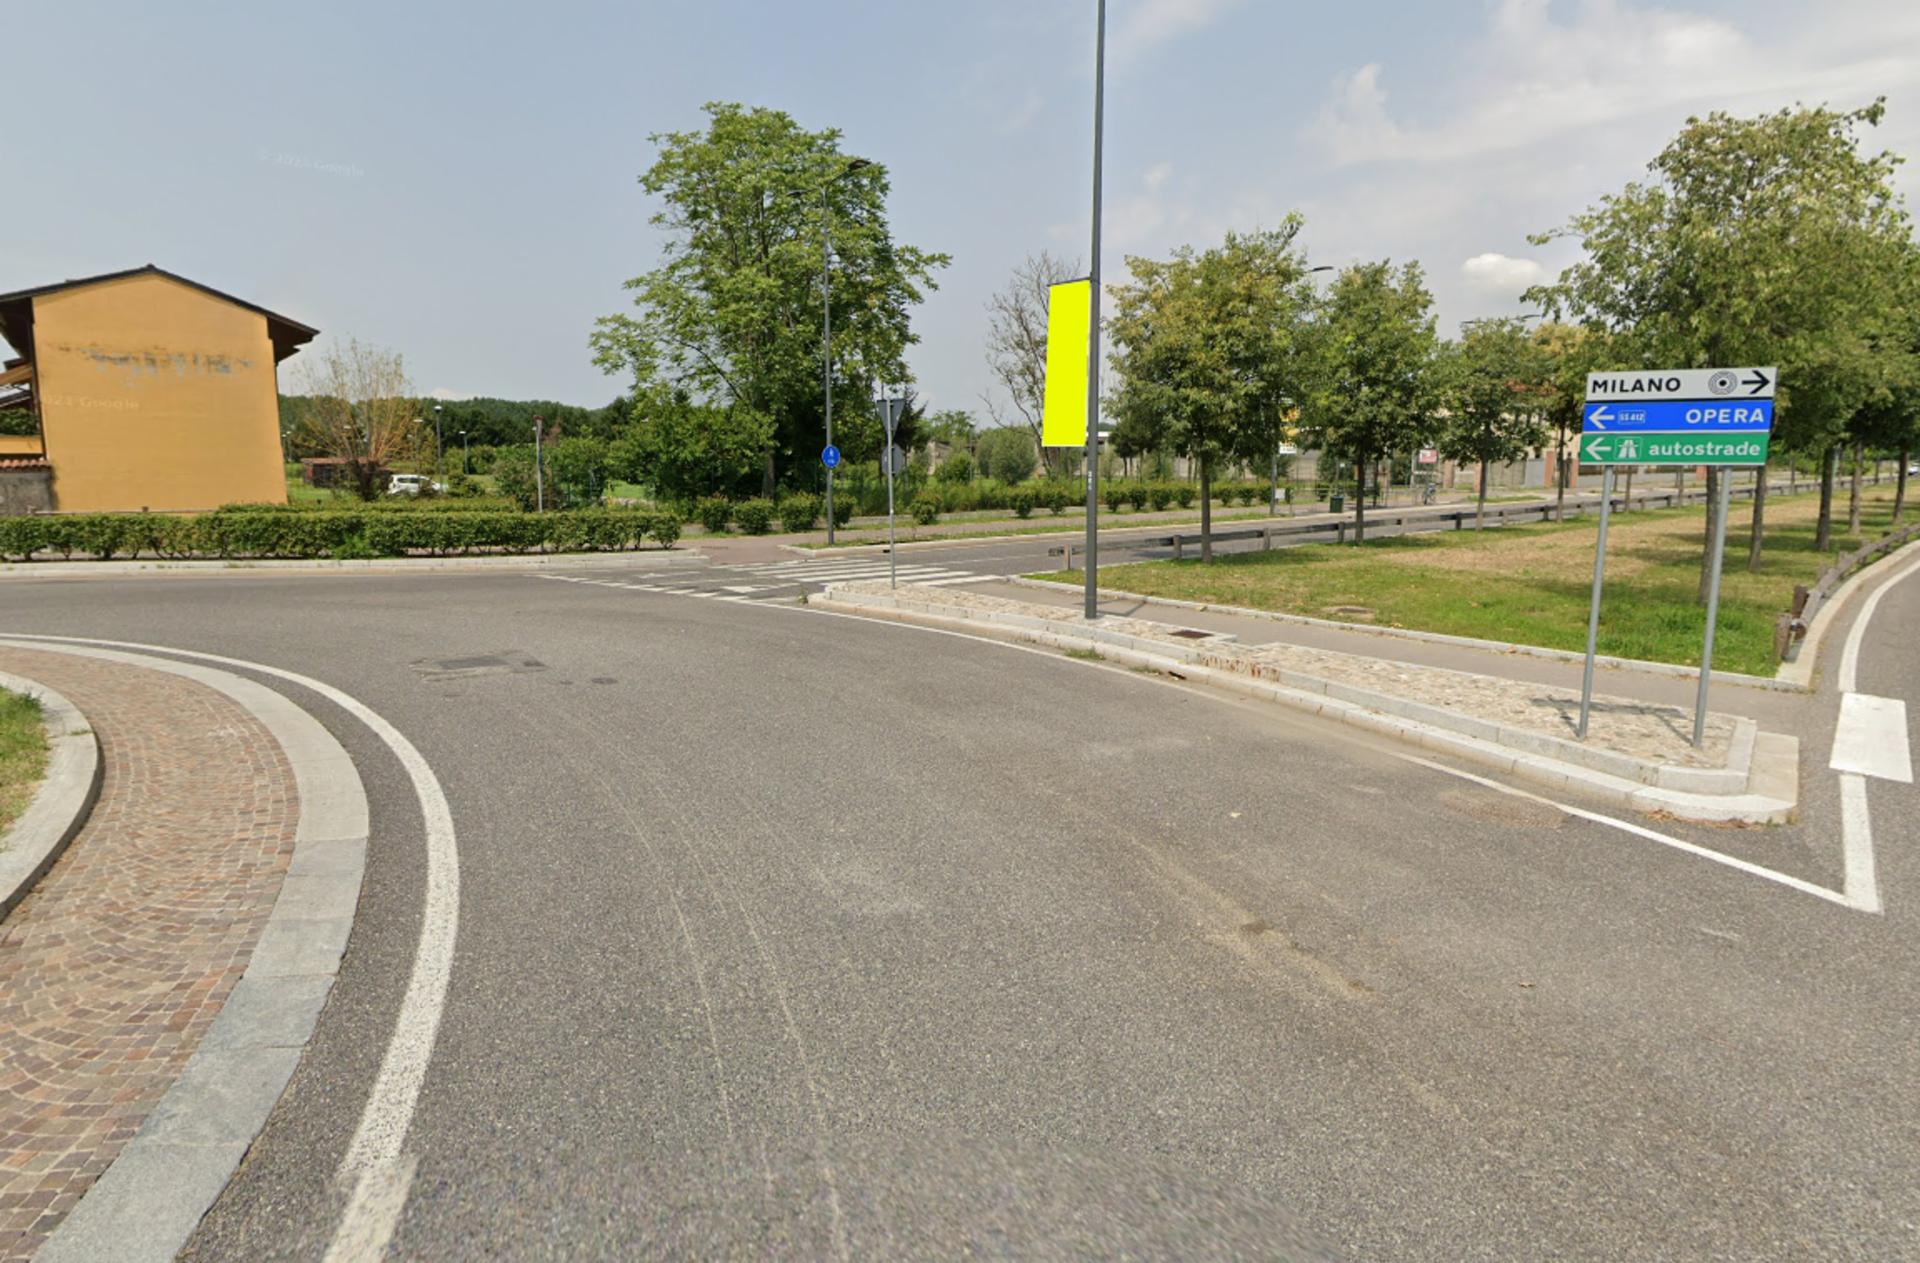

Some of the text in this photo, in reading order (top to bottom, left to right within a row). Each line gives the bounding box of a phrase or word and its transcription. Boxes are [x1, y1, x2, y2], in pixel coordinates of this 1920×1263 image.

[1592, 378, 1681, 393] MILANO
[1685, 409, 1764, 424] OPERA
[1649, 441, 1761, 456] autostrade
